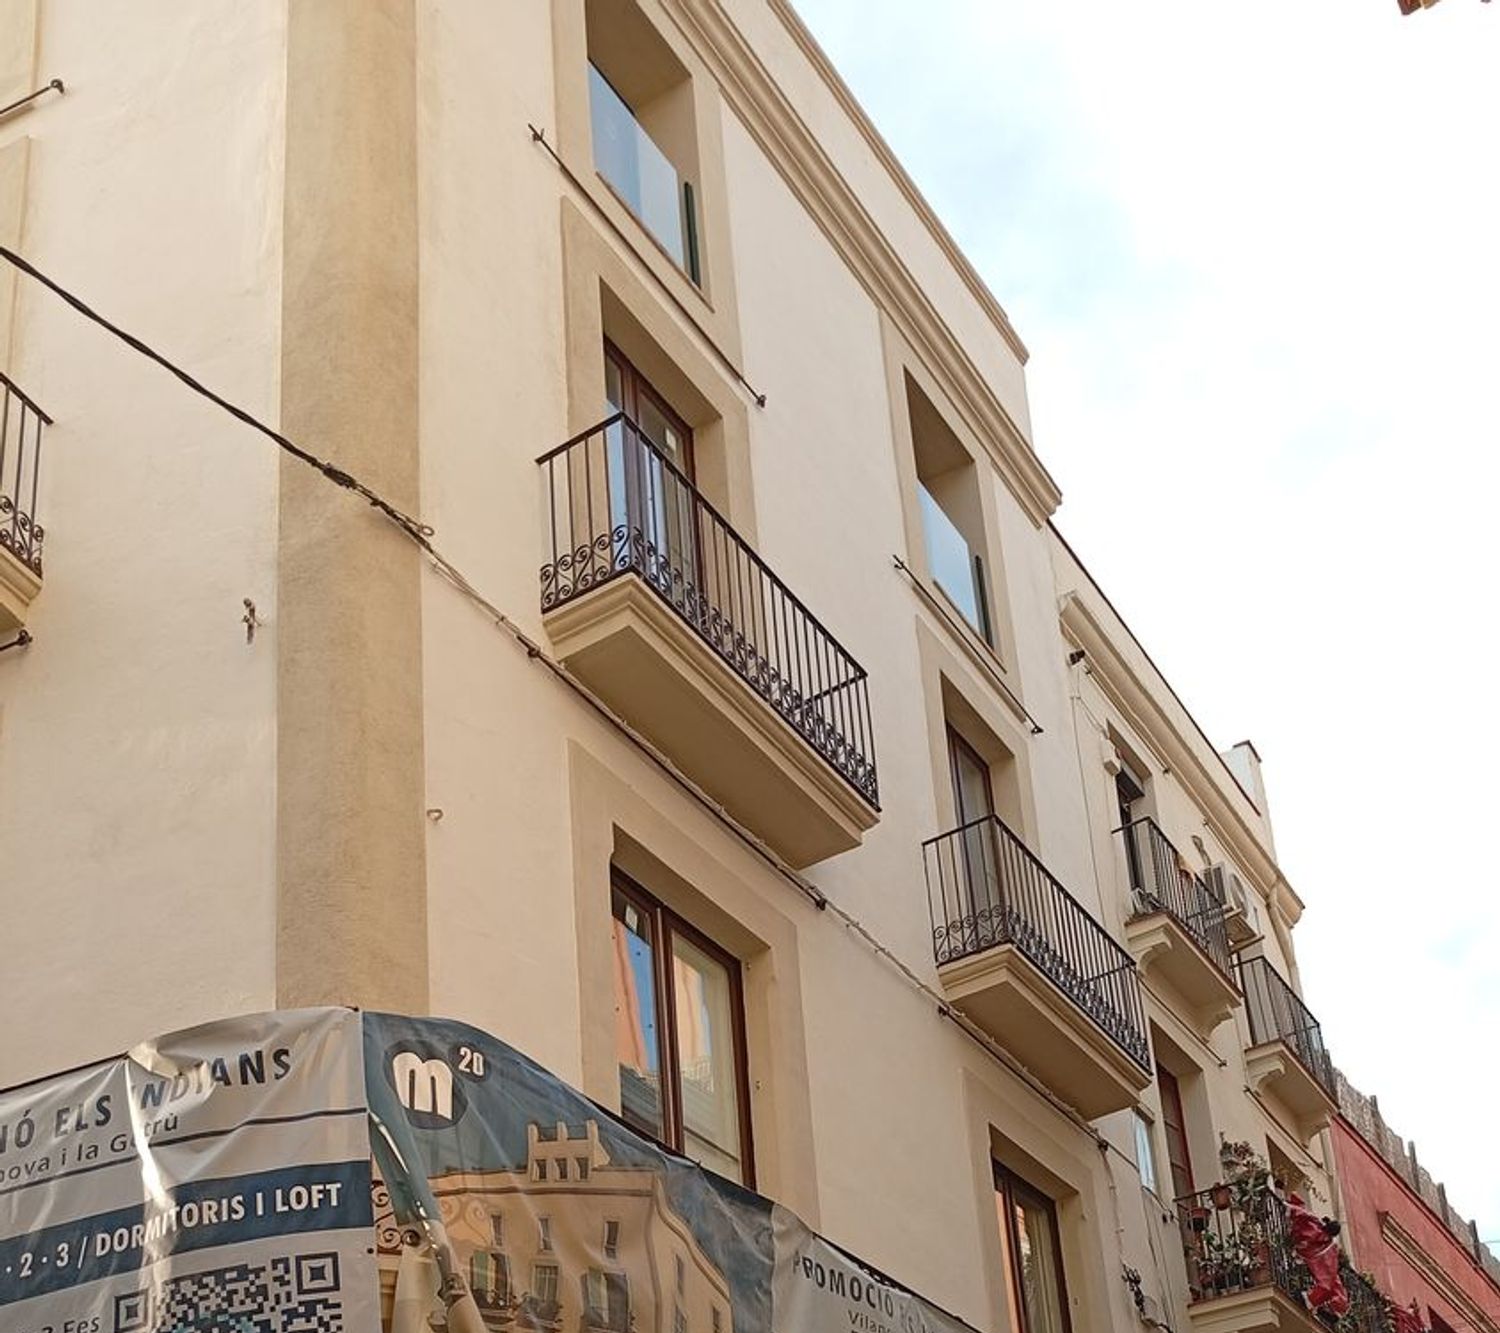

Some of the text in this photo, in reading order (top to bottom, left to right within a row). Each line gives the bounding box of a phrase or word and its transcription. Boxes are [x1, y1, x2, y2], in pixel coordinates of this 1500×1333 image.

[55, 1095, 112, 1138] ELS
[132, 1049, 291, 1109] NDIANS
[458, 1046, 485, 1076] 20
[61, 1147, 67, 1166] i
[77, 1140, 98, 1161] la
[19, 1252, 33, 1278] 2
[56, 1242, 69, 1267] 3
[95, 1195, 245, 1257] DORMITORIS
[256, 1192, 264, 1216] I
[275, 1183, 342, 1213] LOFT
[793, 1250, 895, 1319] PROMOCIÓ
